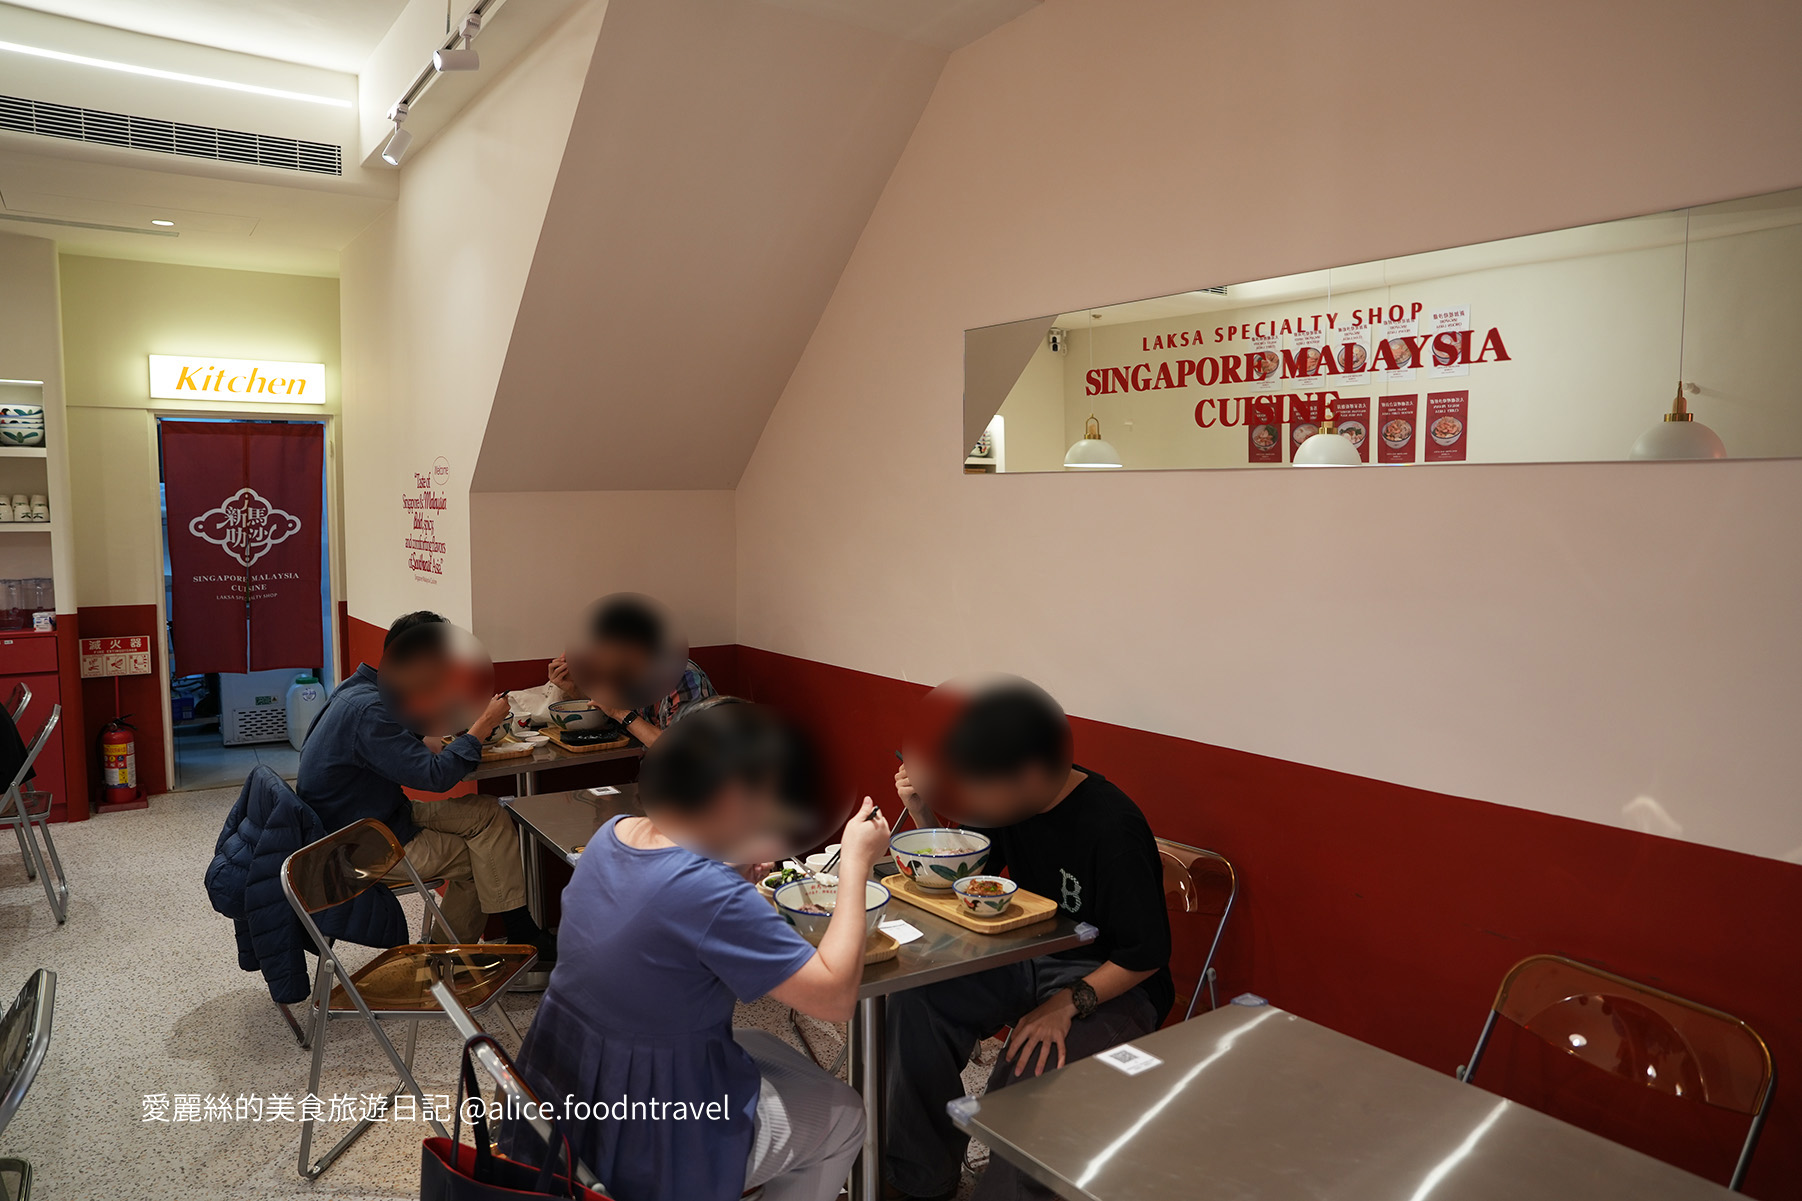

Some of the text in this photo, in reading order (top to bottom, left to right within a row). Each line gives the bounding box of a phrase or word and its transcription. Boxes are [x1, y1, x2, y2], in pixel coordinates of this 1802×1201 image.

[1142, 330, 1204, 352] LAKSA
[1214, 312, 1339, 343] SPECIALTY
[1352, 301, 1424, 325] SHOP
[175, 365, 307, 395] Kitchen
[1085, 326, 1512, 396] SINGAPORE MALAYSIA
[1194, 390, 1341, 428] CUISINE
[251, 572, 299, 582] MALAYSIA
